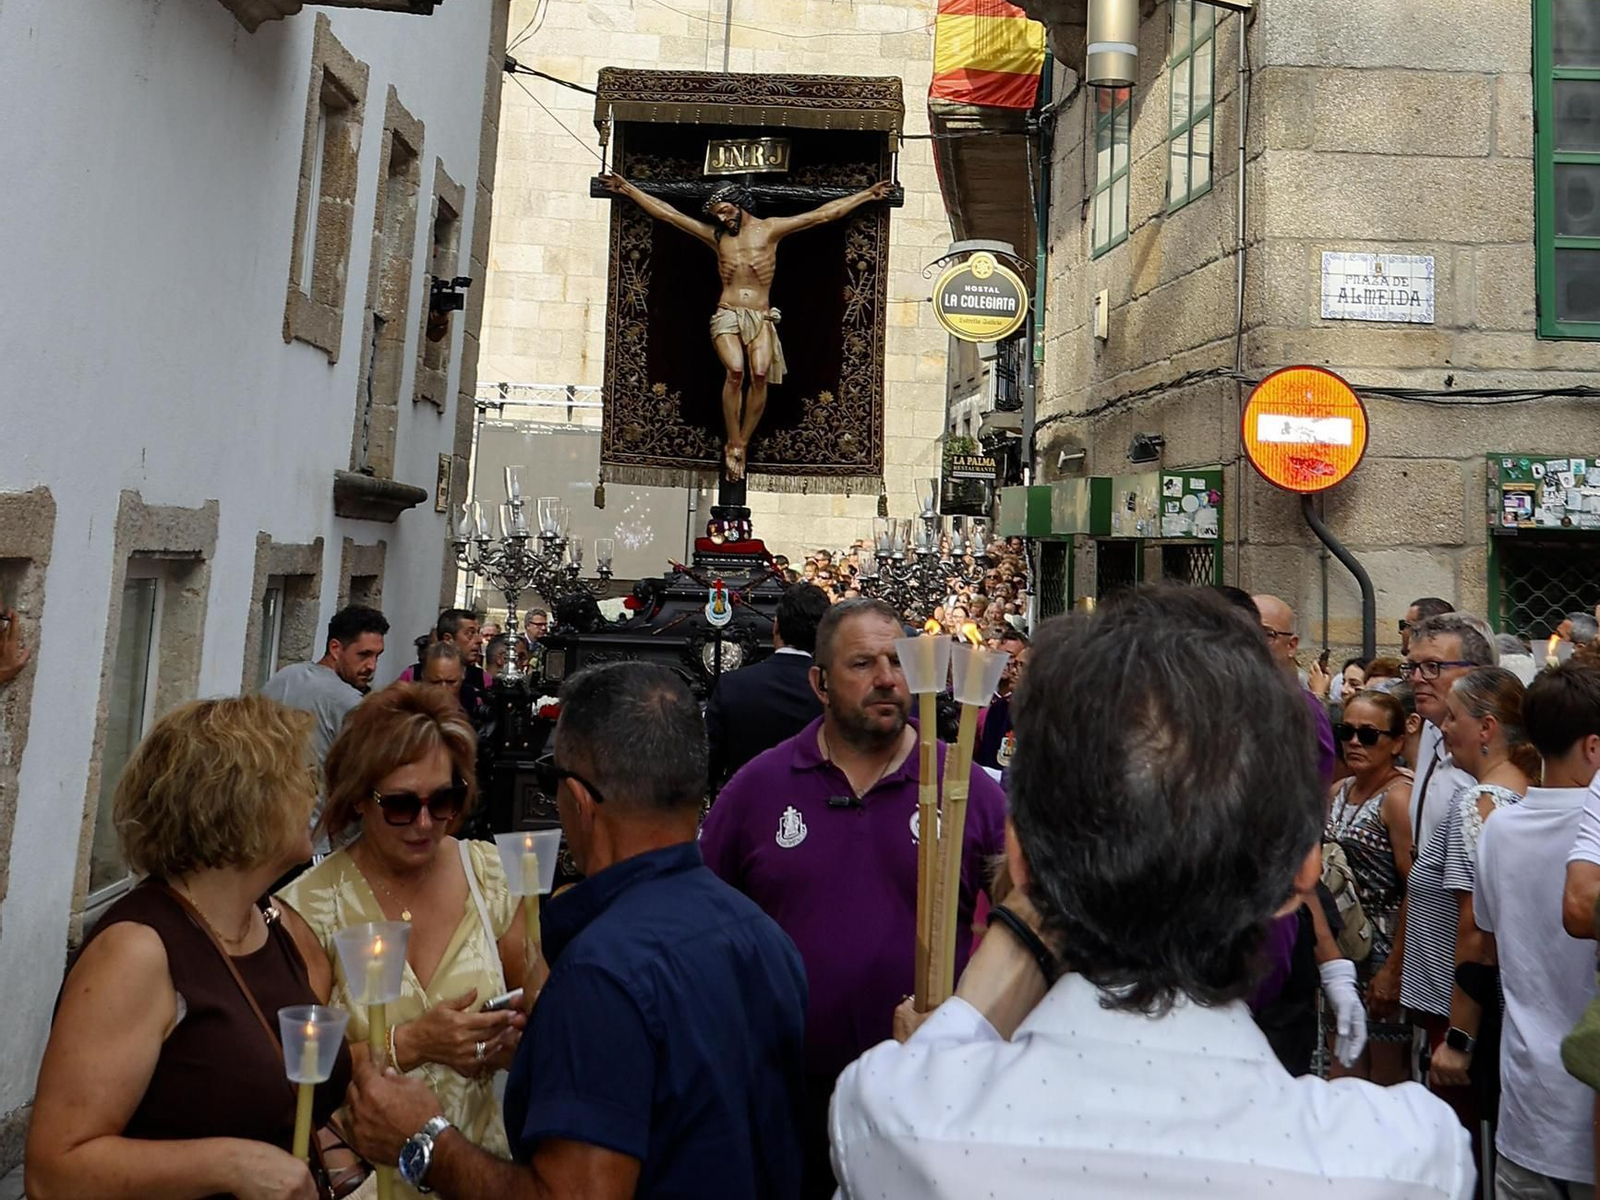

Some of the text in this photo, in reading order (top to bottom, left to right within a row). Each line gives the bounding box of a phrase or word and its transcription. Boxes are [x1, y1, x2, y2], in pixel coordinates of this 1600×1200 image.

[1345, 274, 1410, 287] PRAZA DE
[964, 285, 1000, 294] HOSTAL
[944, 293, 1016, 311] LA COLEGIATA
[1337, 287, 1422, 307] ALMEIDA
[953, 455, 996, 466] LA PALMA
